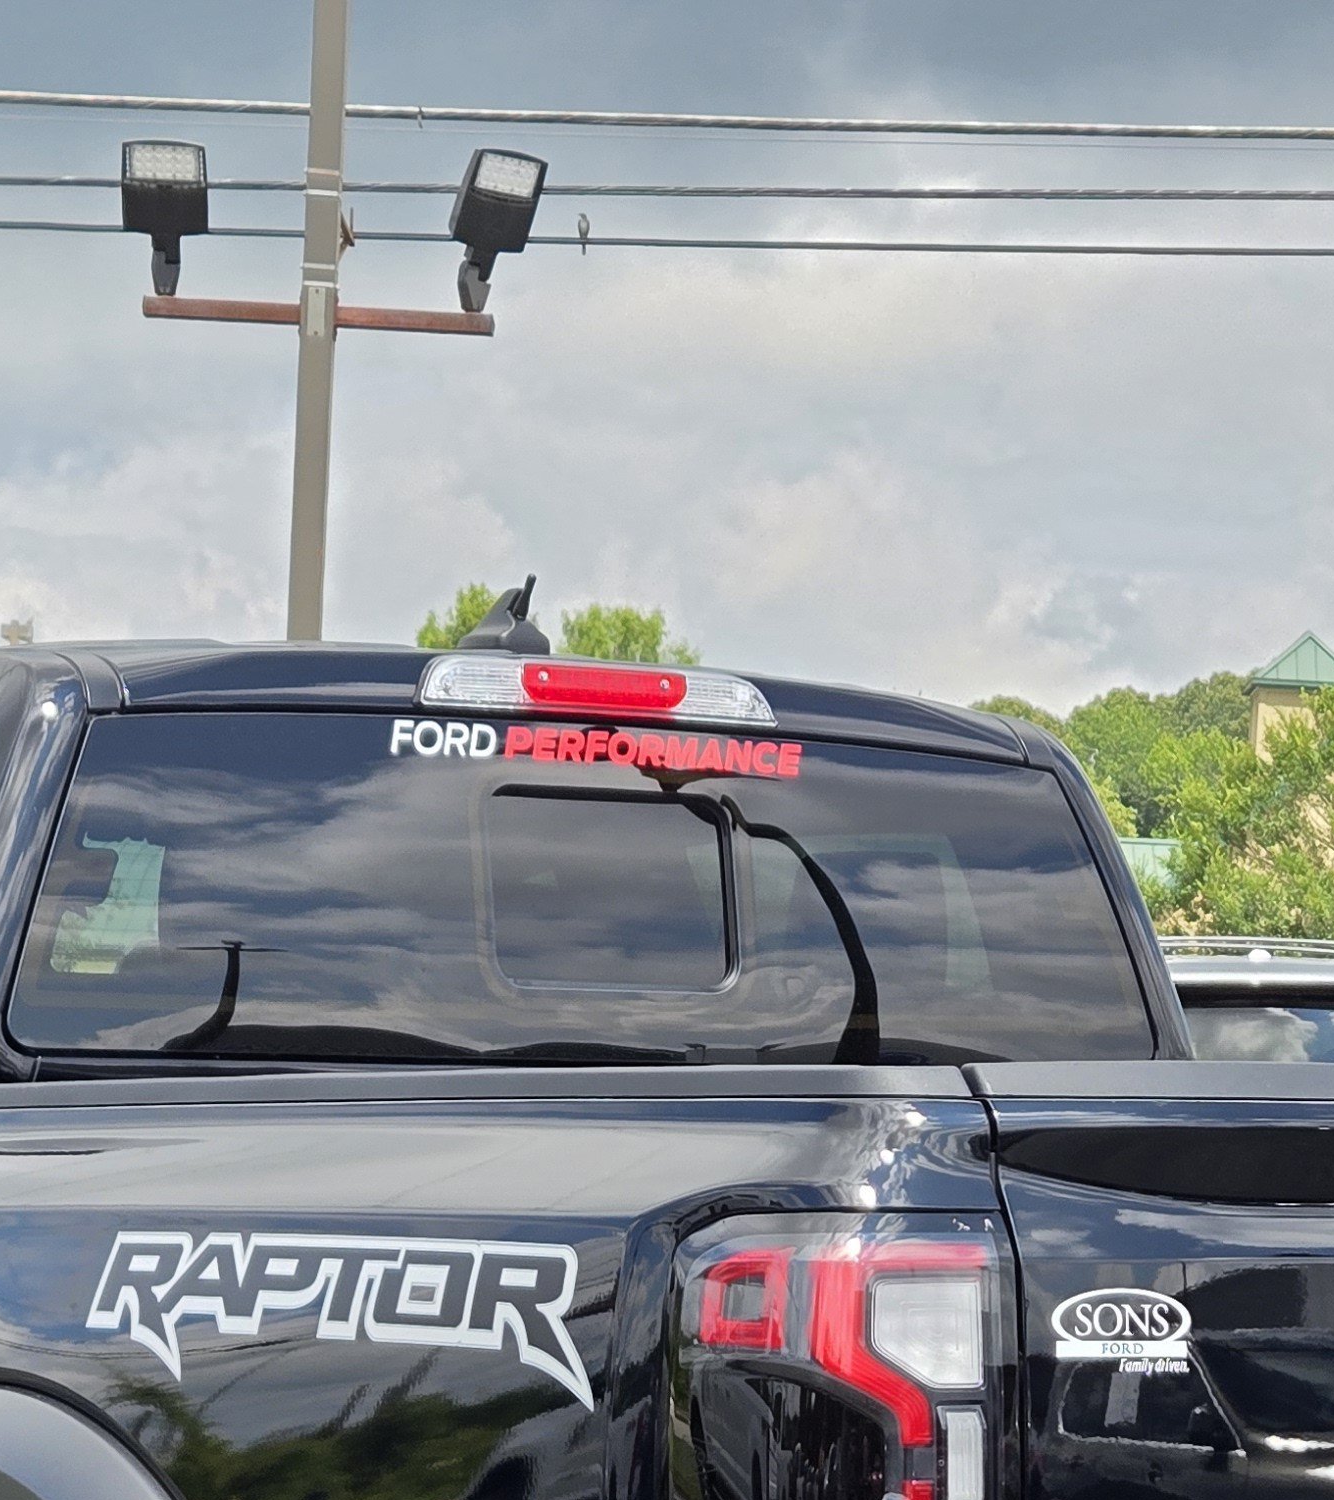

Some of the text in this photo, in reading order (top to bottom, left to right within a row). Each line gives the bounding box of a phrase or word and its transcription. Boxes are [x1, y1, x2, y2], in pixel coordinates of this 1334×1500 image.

[389, 719, 803, 776] FORD PERFORMANCE
[85, 1231, 595, 1412] RAPTOR
[1074, 1302, 1170, 1337] SONS
[1101, 1343, 1144, 1355] FORD
[1118, 1357, 1153, 1376] Family
